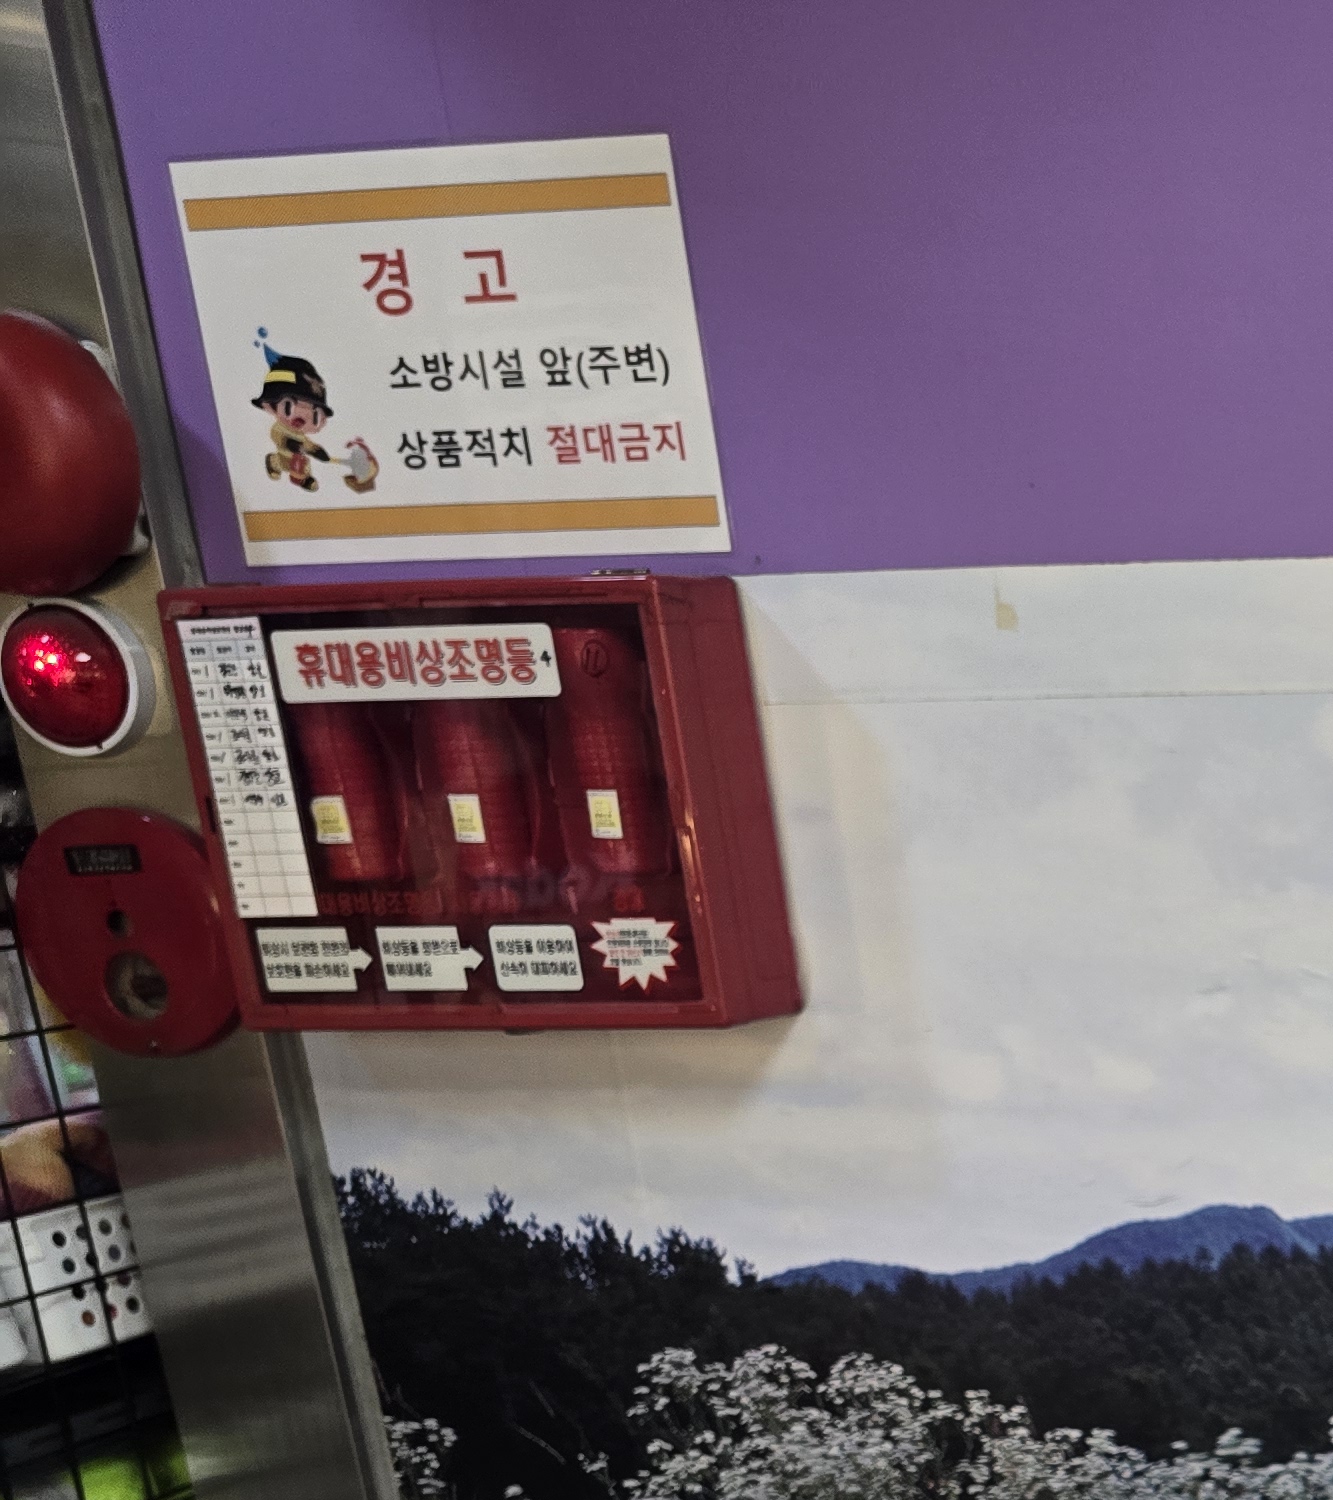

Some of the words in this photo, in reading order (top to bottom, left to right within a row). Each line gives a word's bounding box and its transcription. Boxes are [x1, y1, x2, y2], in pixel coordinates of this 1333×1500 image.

[358, 248, 414, 317] 경
[462, 248, 518, 305] 고
[389, 346, 525, 393] 소방시설
[539, 342, 671, 390] 앞(주변)
[396, 426, 534, 471] 상품적치
[546, 421, 688, 466] 절대금지
[294, 637, 538, 689] 휴대용비상조명등
